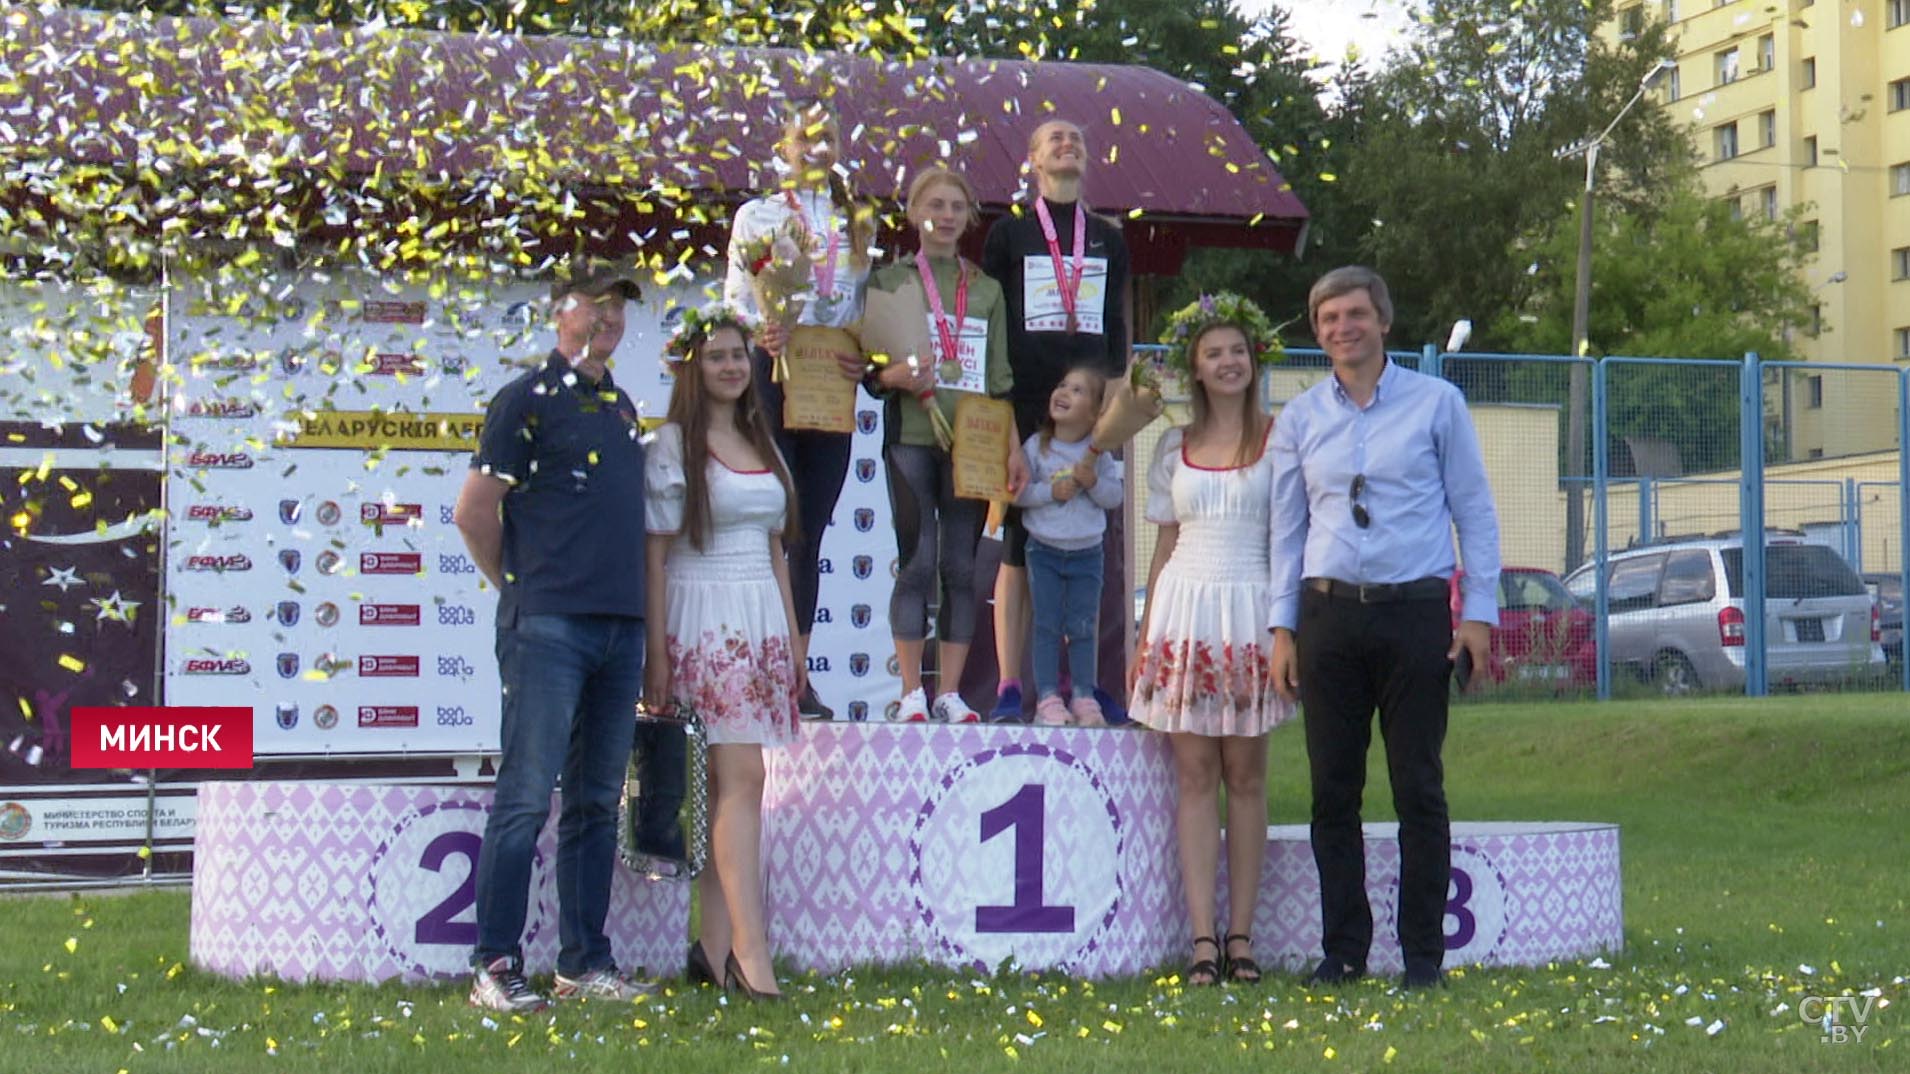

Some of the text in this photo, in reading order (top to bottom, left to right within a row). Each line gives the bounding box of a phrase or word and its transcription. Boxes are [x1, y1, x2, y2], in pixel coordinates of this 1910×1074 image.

[299, 419, 437, 438] ЕЛАРУСКІЯ
[44, 808, 176, 820] МИНИСТЕРСТВО СПОТА И
[44, 820, 90, 830] ТУРИЗМА
[92, 818, 158, 830] РЕСПУБЛИИ
[976, 784, 1075, 933] 1
[415, 831, 483, 945] 2
